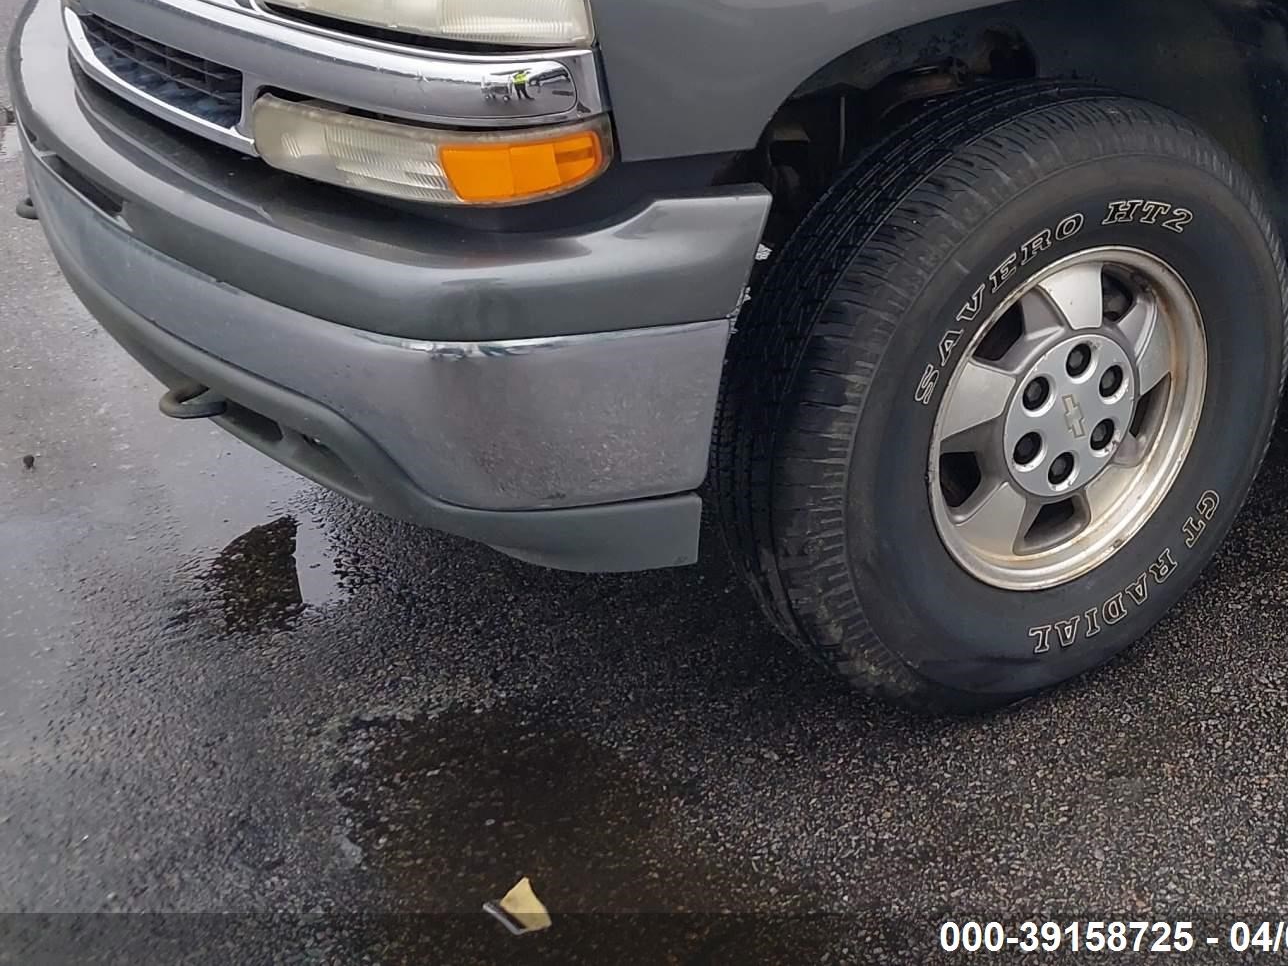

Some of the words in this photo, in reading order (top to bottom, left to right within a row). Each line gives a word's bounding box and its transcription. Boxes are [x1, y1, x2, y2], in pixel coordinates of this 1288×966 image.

[914, 213, 1084, 404] SAVERO
[1102, 200, 1193, 233] HT2
[1182, 490, 1220, 547] GT
[1028, 548, 1178, 654] RADIAL
